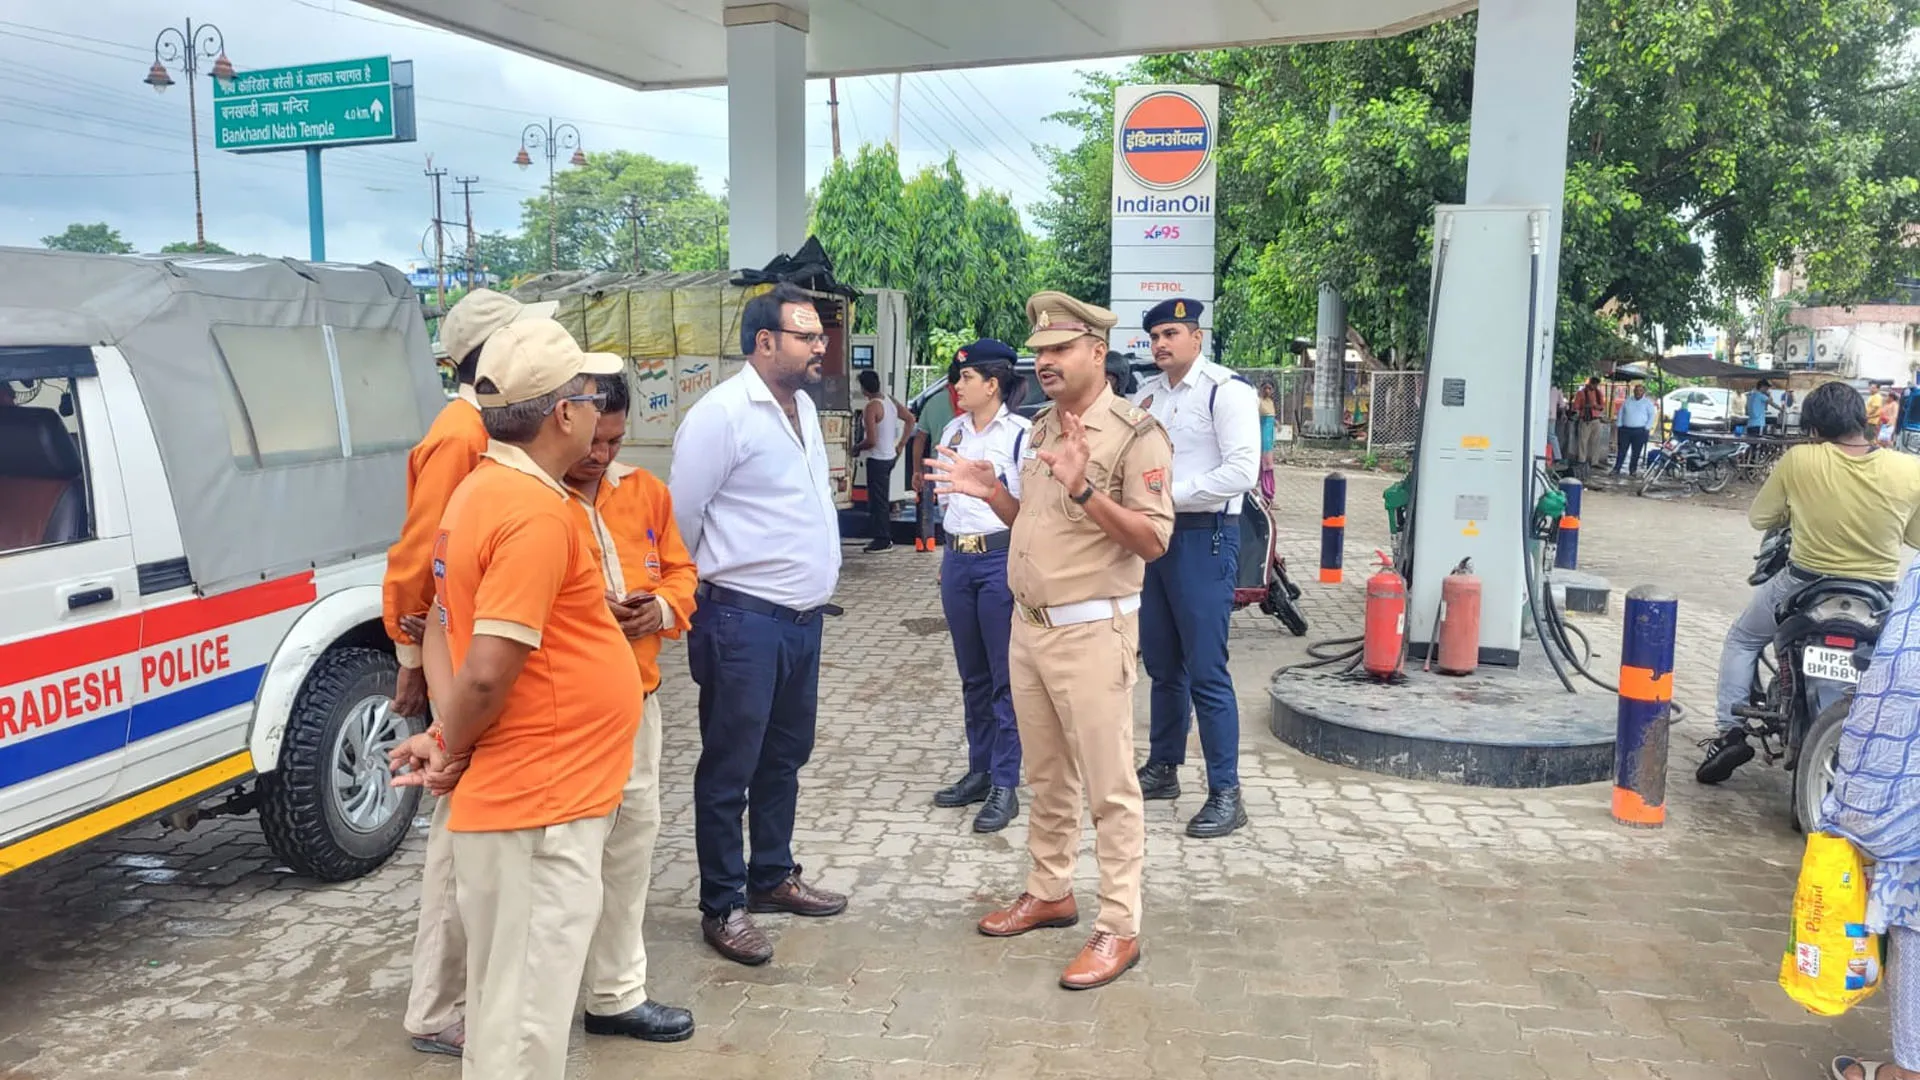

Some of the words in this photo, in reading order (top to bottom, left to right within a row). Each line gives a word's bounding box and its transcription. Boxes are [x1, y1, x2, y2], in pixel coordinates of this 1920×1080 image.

[222, 124, 271, 144] Bankhandi
[272, 123, 297, 140] Nath
[299, 120, 335, 138] Temple
[1126, 131, 1203, 150] इंडियनऑयल
[1116, 195, 1210, 213] IndianOil
[1140, 281, 1184, 292] PETROL
[1819, 651, 1851, 667] UP2
[0, 666, 122, 739] RADESH
[141, 634, 230, 693] POLICE
